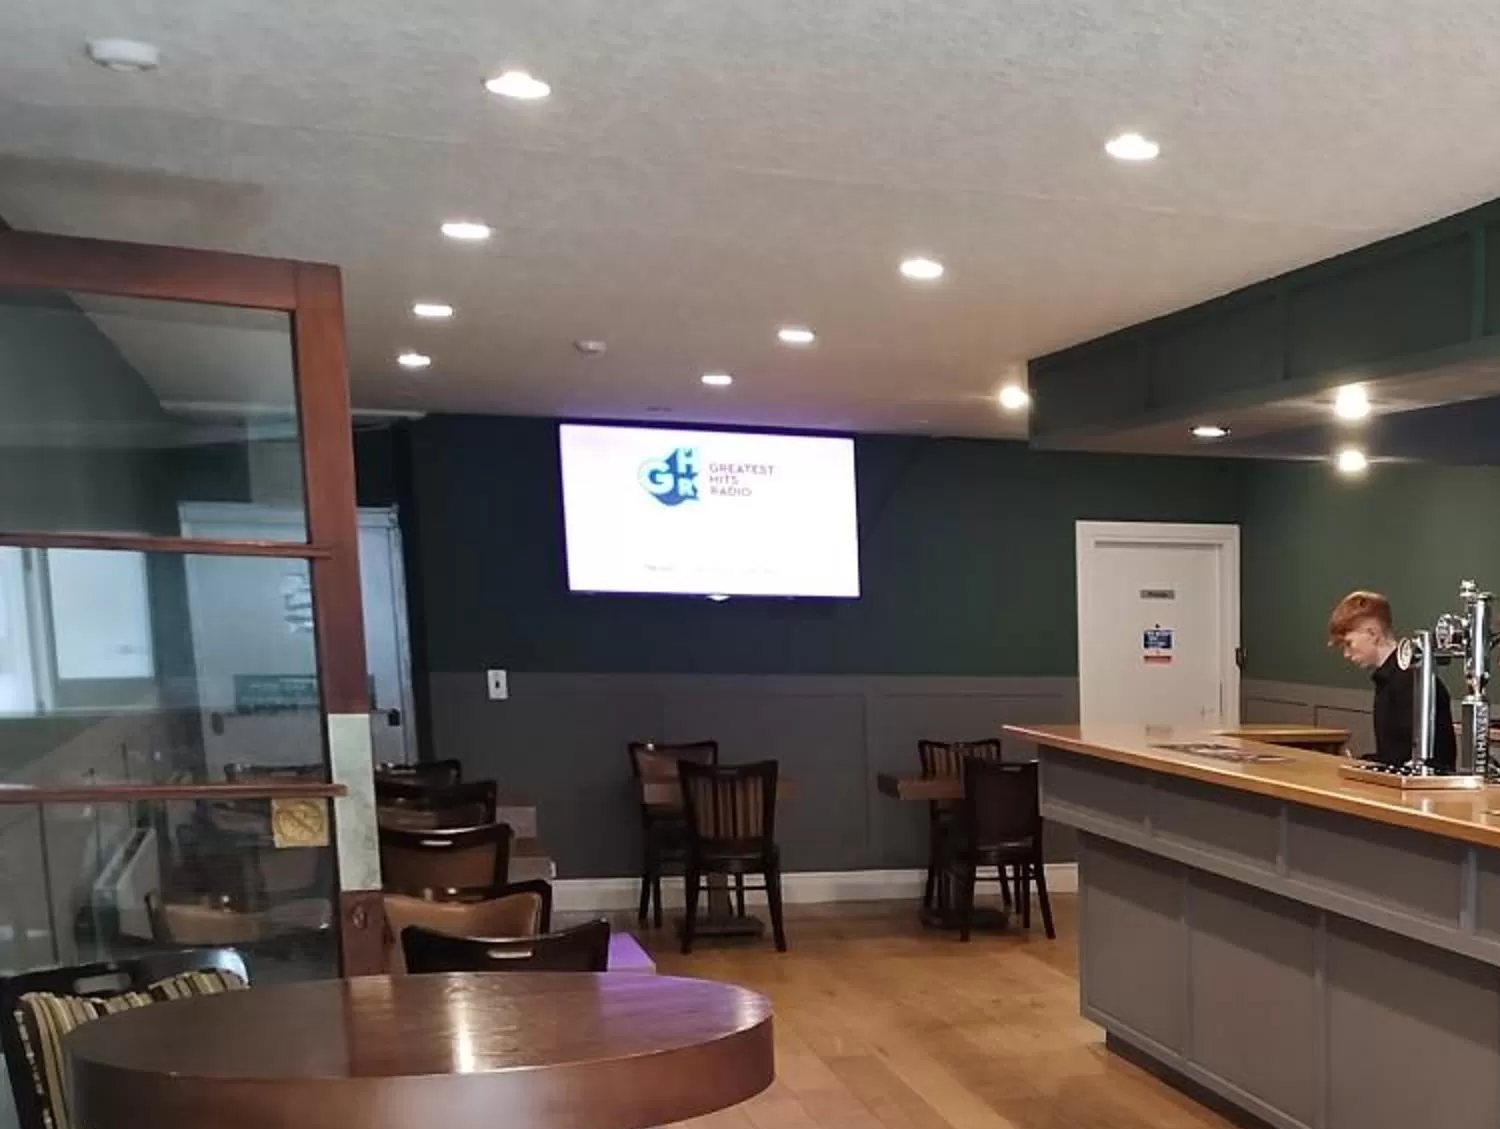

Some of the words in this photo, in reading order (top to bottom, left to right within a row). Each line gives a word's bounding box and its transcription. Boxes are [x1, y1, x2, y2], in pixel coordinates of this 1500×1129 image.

[708, 463, 775, 475] GREATEST
[708, 475, 739, 486] HITS
[708, 486, 753, 497] RADIO
[1475, 706, 1488, 773] BELHAVEN
